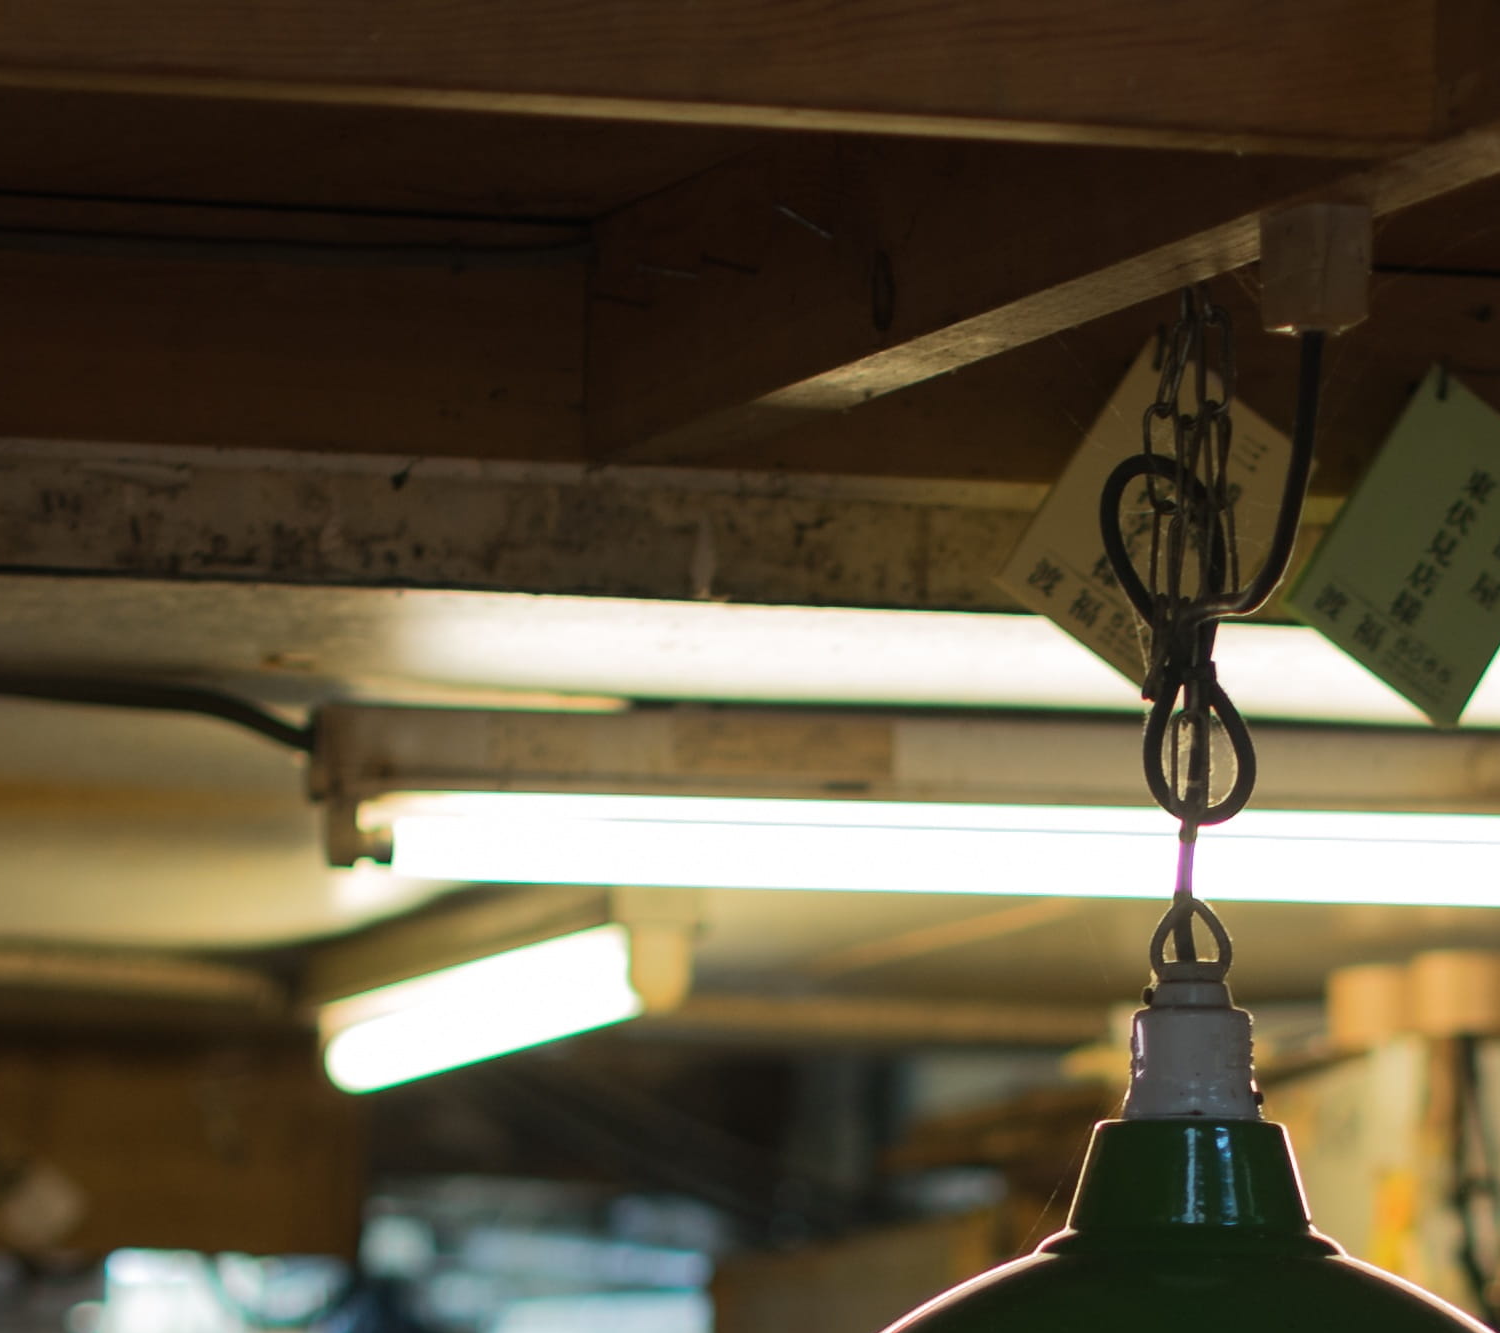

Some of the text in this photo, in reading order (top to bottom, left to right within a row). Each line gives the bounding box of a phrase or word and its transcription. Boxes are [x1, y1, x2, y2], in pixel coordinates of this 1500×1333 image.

[1391, 467, 1500, 628] 東伏見店様
